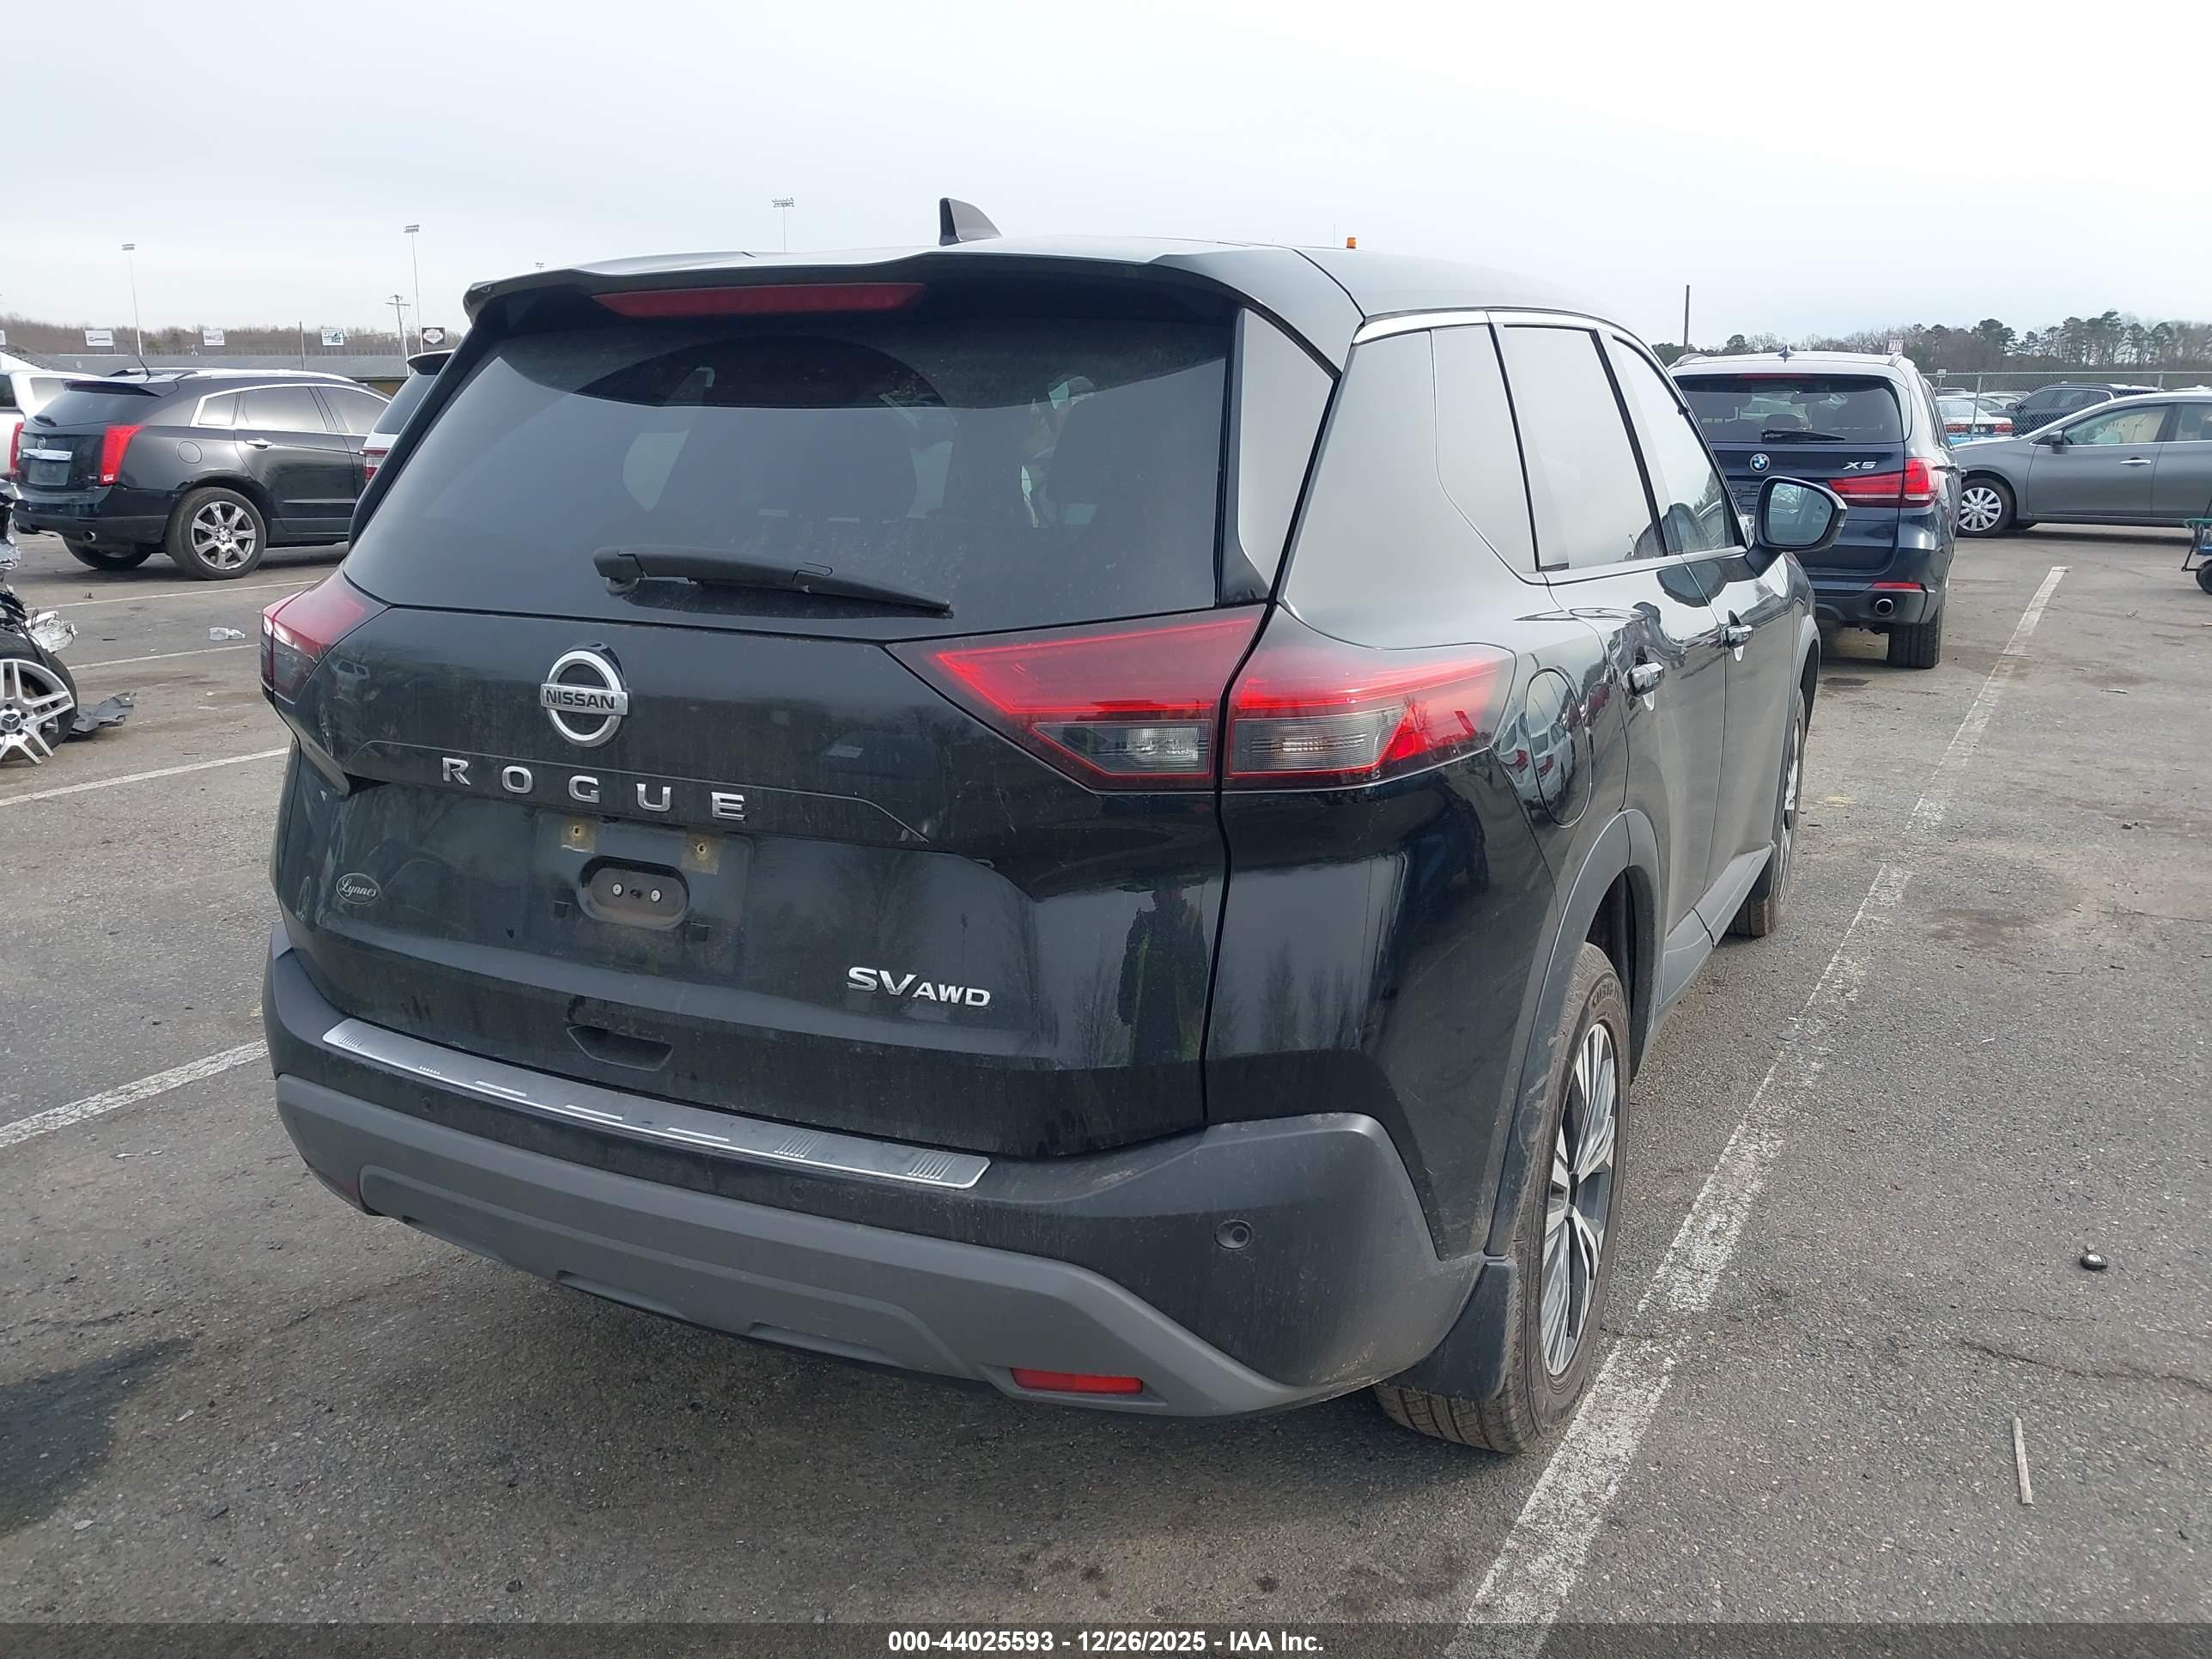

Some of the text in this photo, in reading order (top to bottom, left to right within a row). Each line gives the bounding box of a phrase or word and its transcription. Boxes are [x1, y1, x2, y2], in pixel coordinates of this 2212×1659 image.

[1842, 461, 1878, 471] X5
[545, 690, 615, 710] NISSAN
[441, 757, 746, 822] ROGUE
